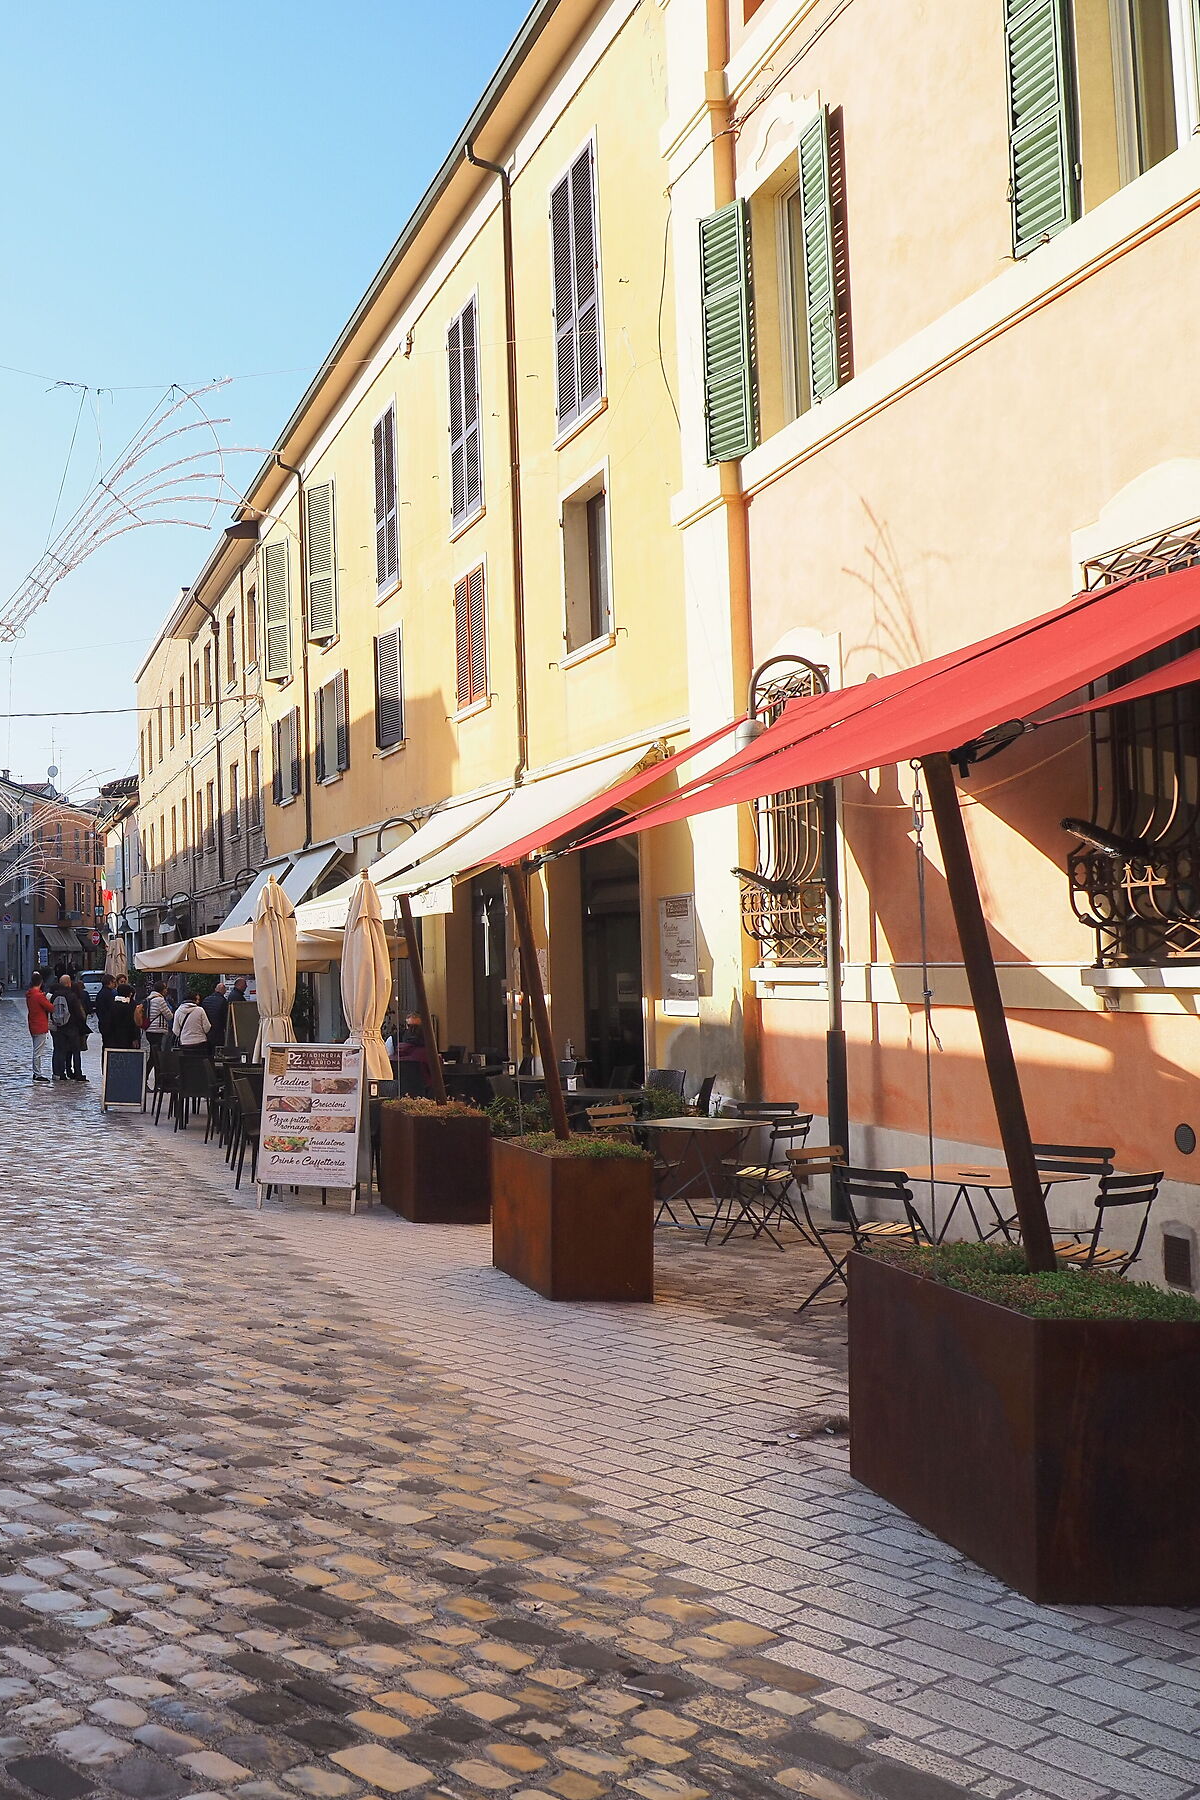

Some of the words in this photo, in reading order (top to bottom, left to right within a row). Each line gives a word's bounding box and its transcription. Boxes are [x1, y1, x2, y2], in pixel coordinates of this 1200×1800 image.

[286, 1051, 302, 1065] PZ
[273, 1075, 310, 1087] Piadine
[311, 1098, 347, 1109] Crescioni
[268, 1113, 289, 1128] Pizza
[290, 1115, 310, 1126] fritta
[280, 1124, 321, 1135] romagnola
[308, 1137, 346, 1147] Insalatone
[271, 1154, 295, 1165] Drink
[301, 1156, 347, 1168] Caffetteria
